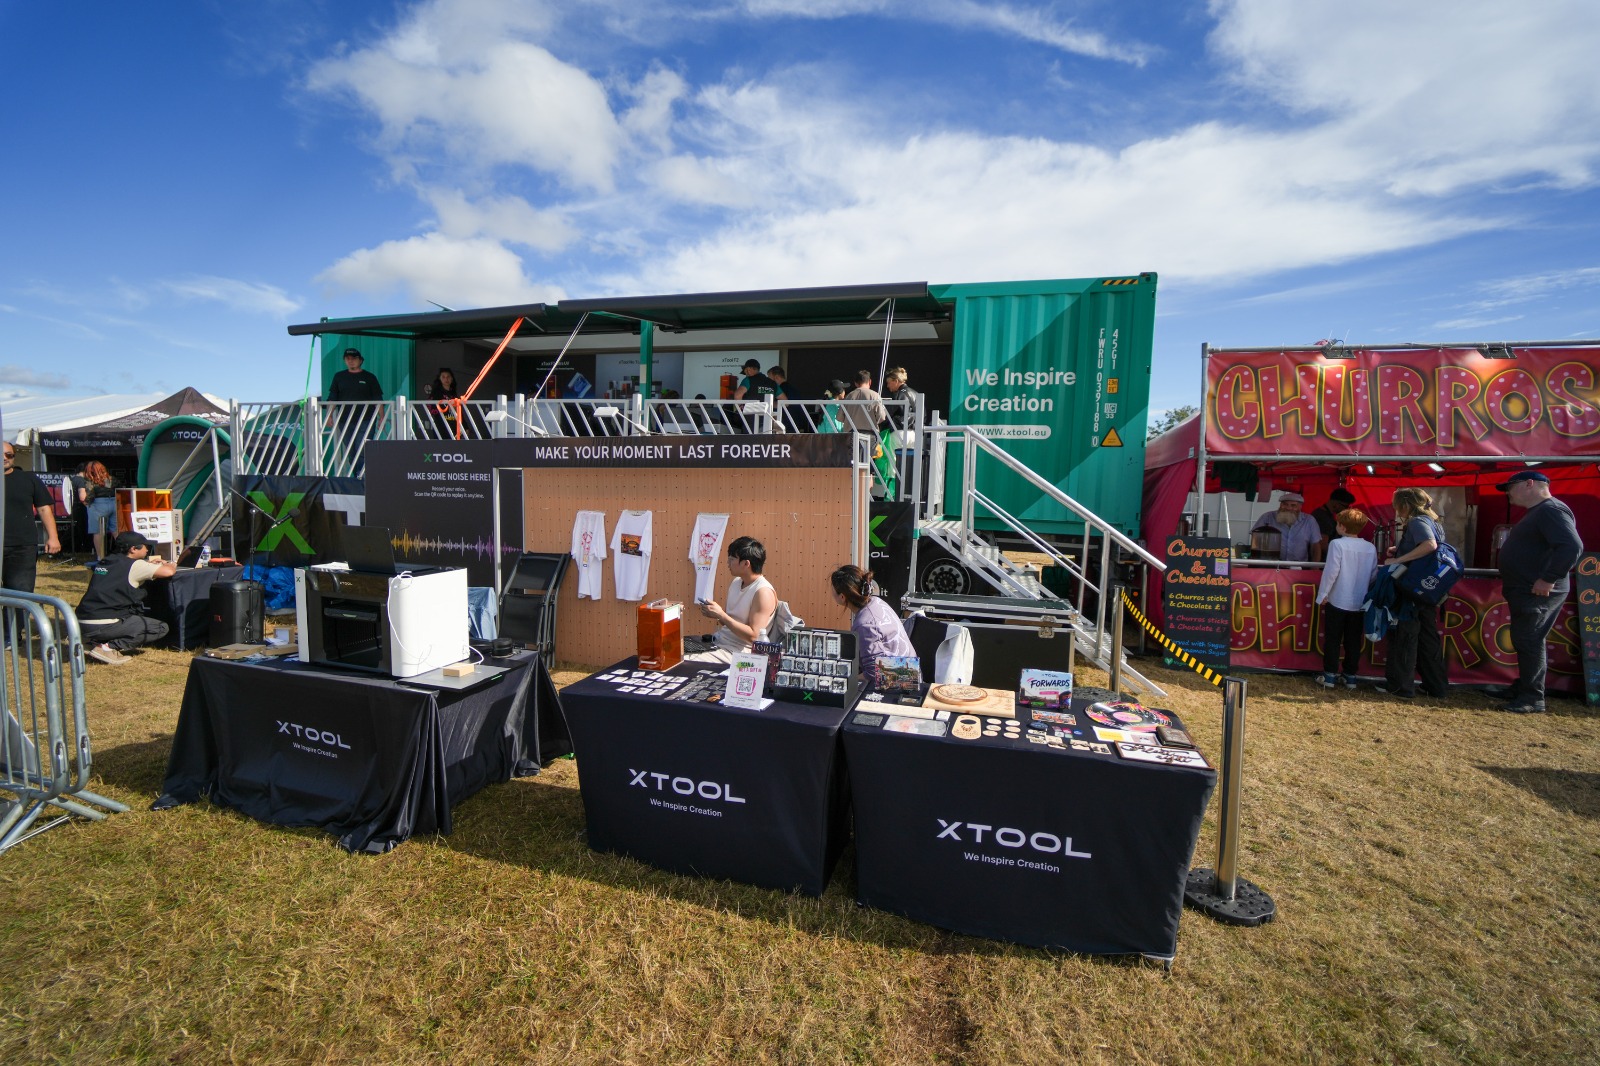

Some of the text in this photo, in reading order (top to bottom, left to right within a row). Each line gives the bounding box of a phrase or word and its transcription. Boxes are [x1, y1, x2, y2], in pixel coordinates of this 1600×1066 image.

[1097, 328, 1105, 369] FWRU
[965, 367, 1076, 390] We Inspire
[964, 394, 1054, 412] Creation
[1216, 361, 1600, 448] CHURROS
[423, 453, 473, 463] XTOOL
[535, 444, 791, 460] MAKE YOUR MOMENT LAST FOREVER
[407, 472, 491, 481] MAKE SOME NOISE HERE!
[1167, 539, 1230, 558] Churros
[1191, 560, 1206, 574] &
[1166, 569, 1230, 586] Chocolate
[1175, 593, 1205, 601] Churros
[1176, 602, 1213, 610] Chocolate
[1176, 615, 1205, 623] Churros
[1208, 617, 1229, 625] sticks
[1177, 624, 1213, 632] Chocolate
[1030, 679, 1071, 689] FORWARDS
[276, 719, 352, 750] XTOOL
[292, 741, 338, 759] We Inspire Creation
[628, 768, 746, 804] XTOOL
[649, 798, 722, 818] We Inspire Creation
[936, 818, 1092, 859] XTOOL
[963, 851, 1060, 873] We Inspire Creation
